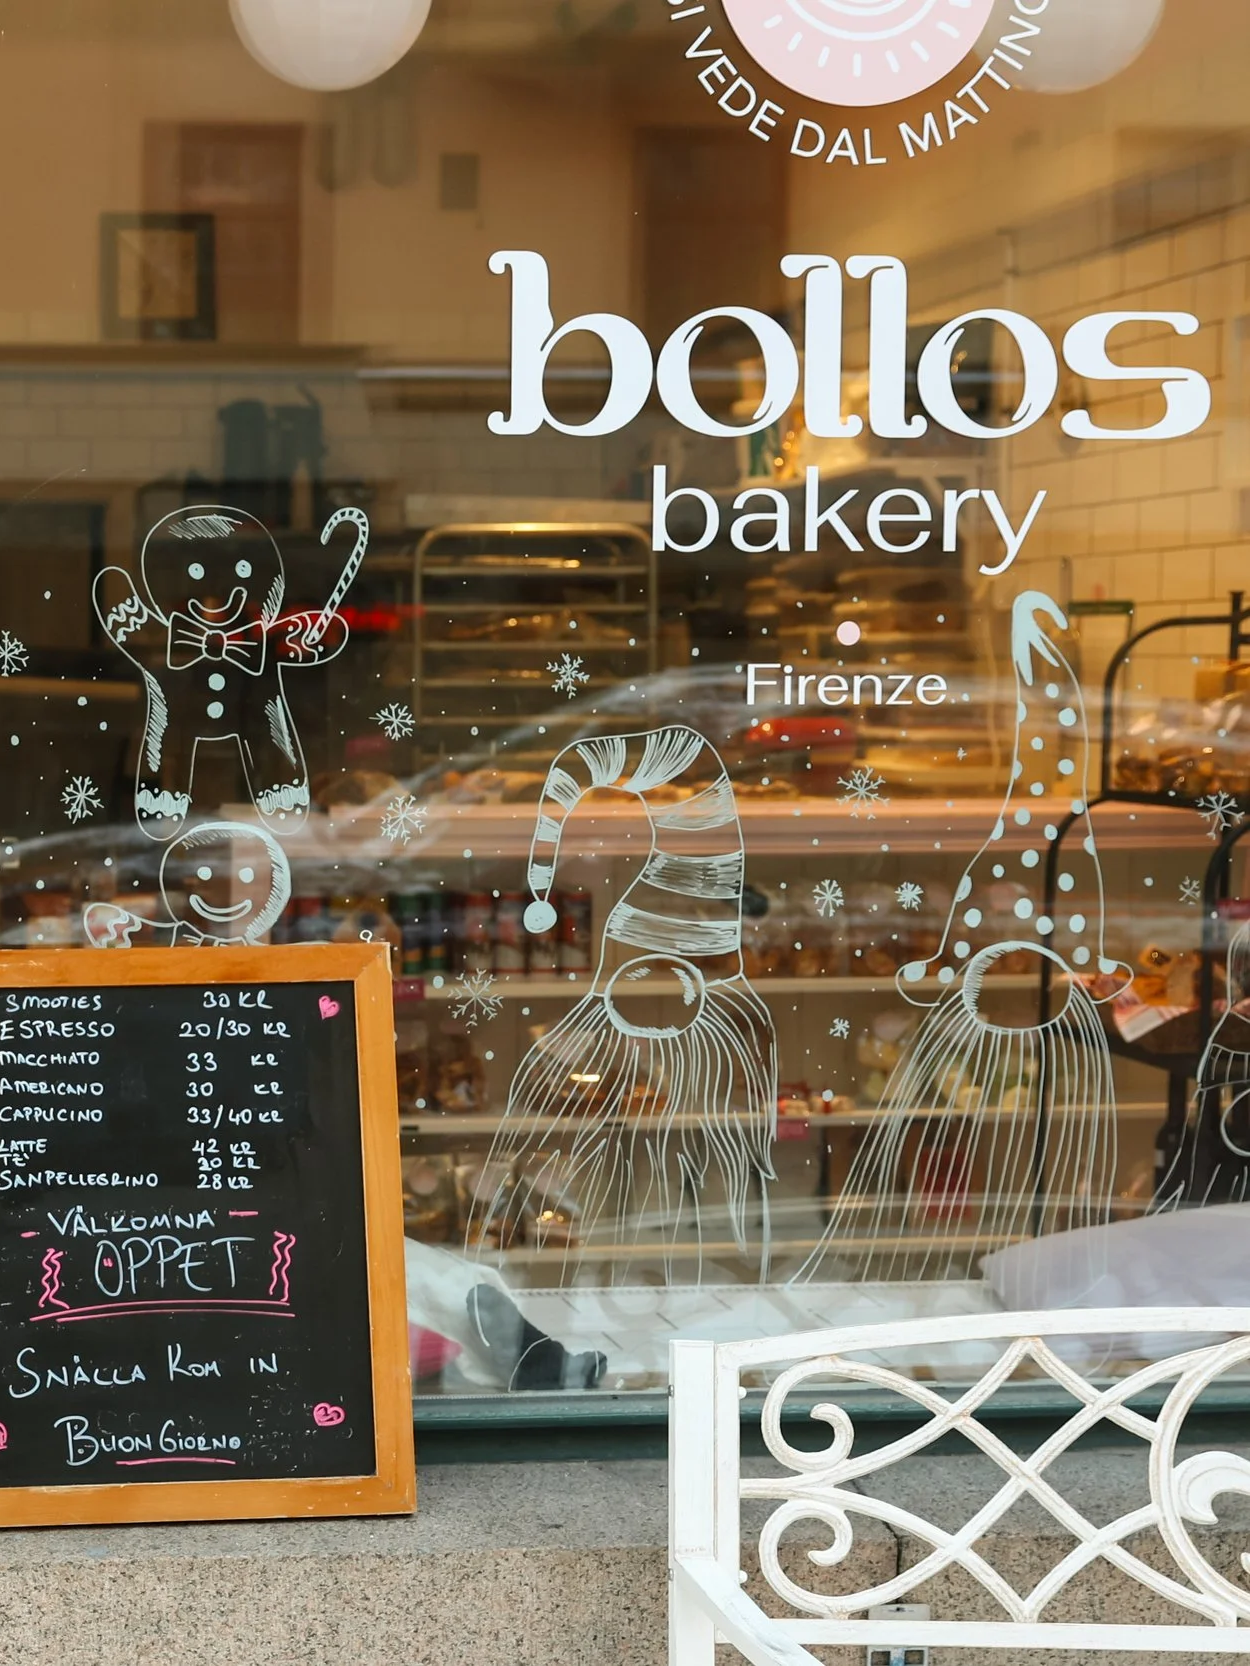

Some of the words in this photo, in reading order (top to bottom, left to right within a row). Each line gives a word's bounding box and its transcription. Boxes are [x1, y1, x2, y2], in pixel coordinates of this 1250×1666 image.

[667, 0, 706, 20] I
[685, 26, 785, 142] VEDE
[790, 117, 887, 166] DAL
[487, 249, 1211, 440] bollos
[652, 464, 1047, 576] bakery
[746, 662, 948, 706] Firenze
[6, 994, 102, 1012] SMOOTIES
[203, 991, 231, 1008] 30
[238, 990, 273, 1009] KR
[0, 1019, 115, 1040] ESPRESSO
[179, 1017, 251, 1040] 20/30
[263, 1022, 291, 1038] KR
[185, 1052, 218, 1072] 33
[251, 1052, 279, 1067] KR
[0, 1077, 104, 1096] AMERICANO
[186, 1082, 214, 1098] 30
[254, 1082, 284, 1096] KR
[187, 1104, 252, 1129] 33/40
[258, 1110, 284, 1123] KR
[191, 1138, 220, 1156] 42
[230, 1141, 257, 1155] KR
[232, 1156, 262, 1169] KR
[196, 1172, 223, 1190] 28
[227, 1175, 254, 1189] KR
[47, 1205, 216, 1237] VÄLKOMNA
[250, 1352, 279, 1374] IN
